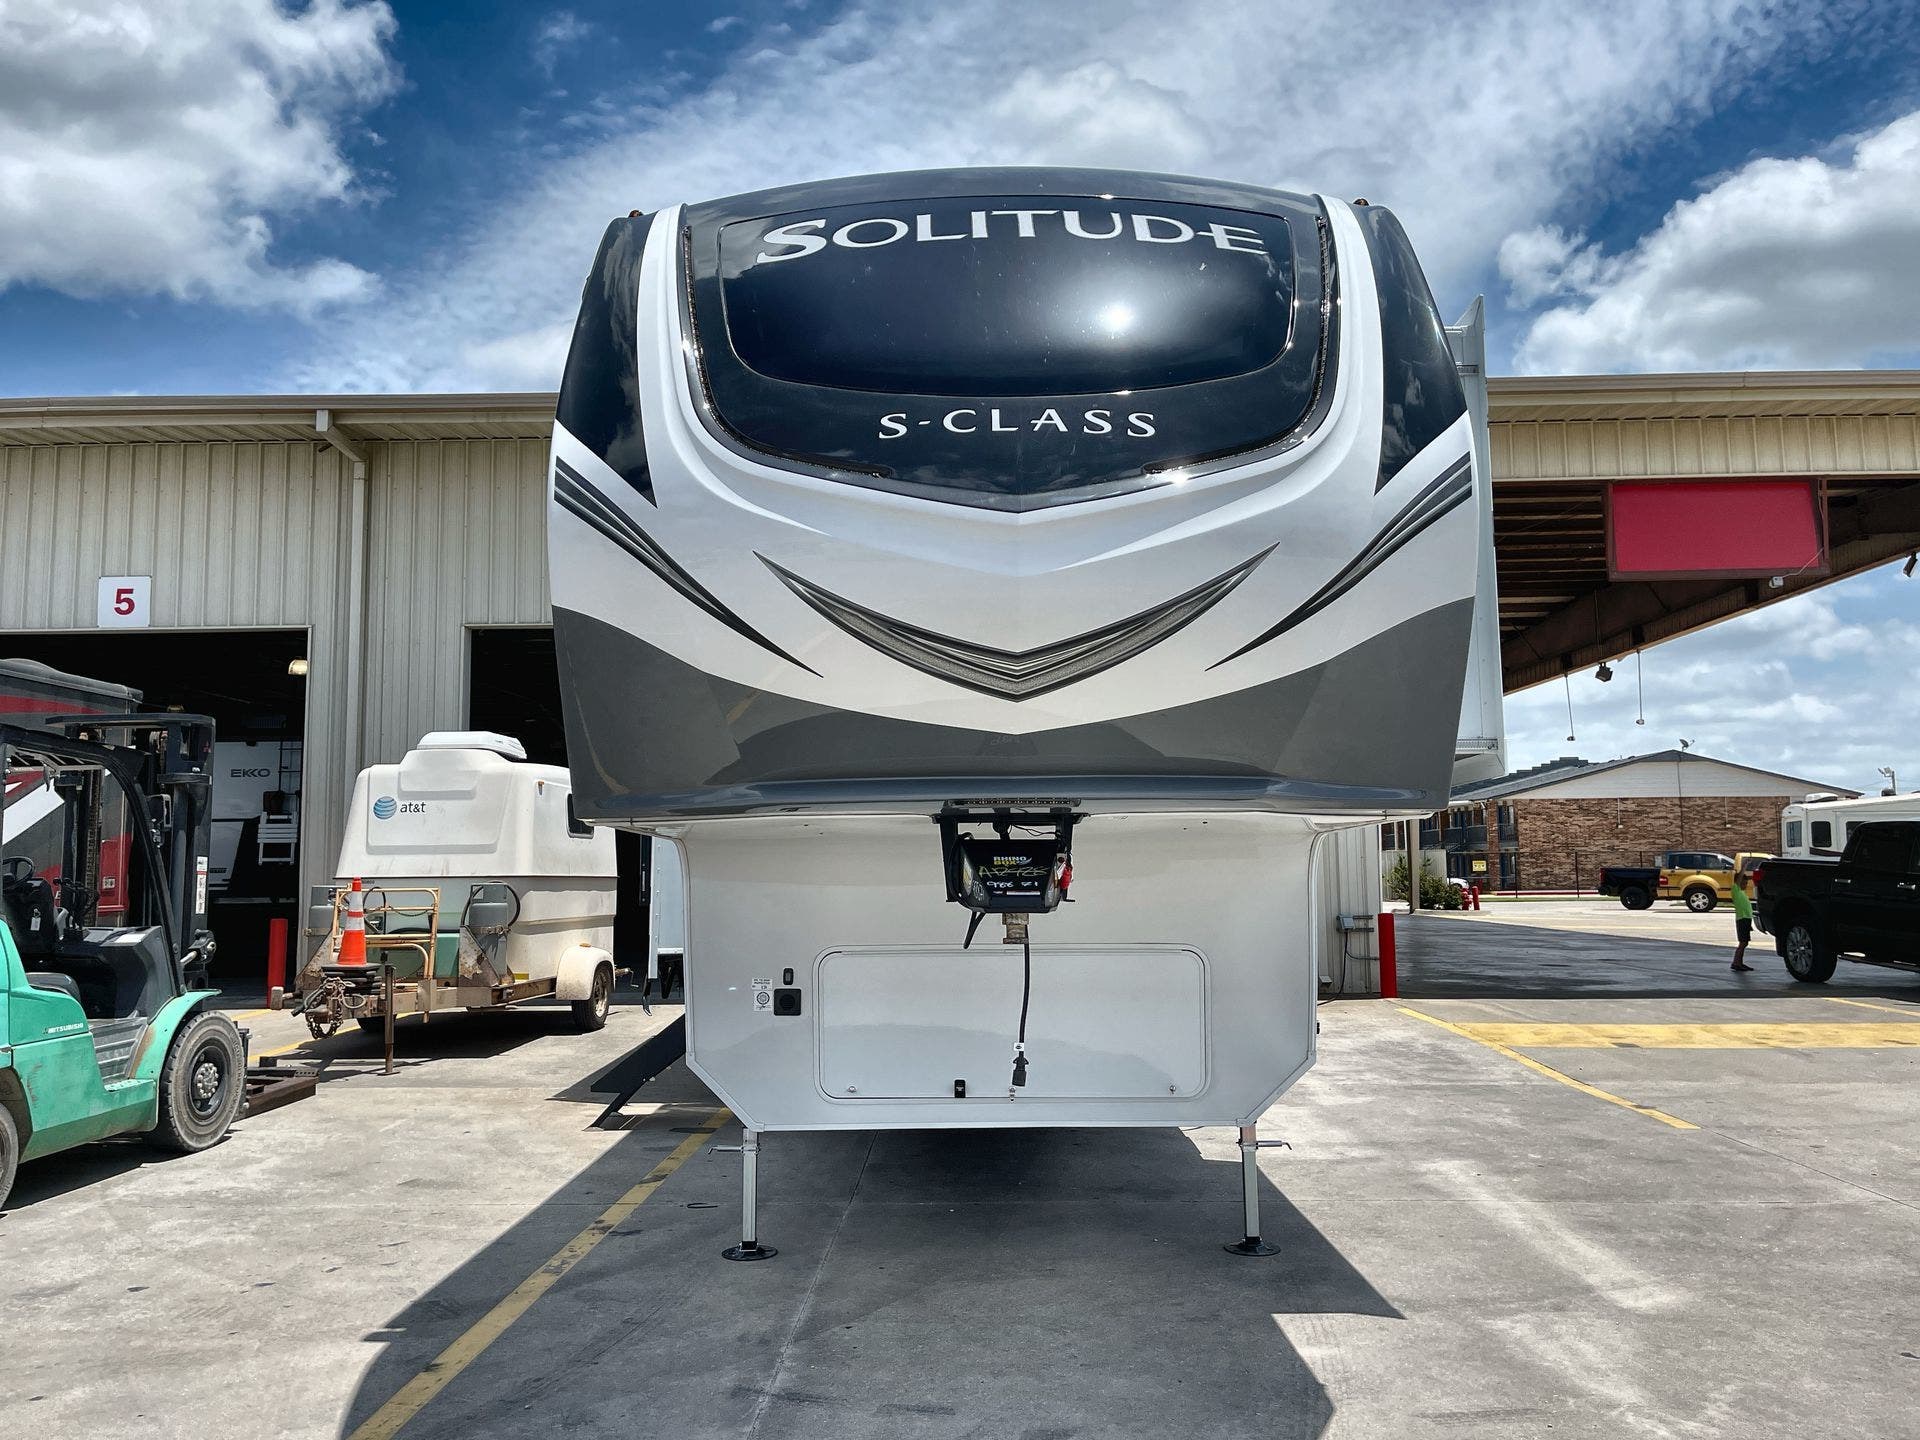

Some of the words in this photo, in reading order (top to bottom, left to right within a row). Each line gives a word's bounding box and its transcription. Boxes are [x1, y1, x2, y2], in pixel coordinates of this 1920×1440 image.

[756, 209, 1268, 264] SOLITUDE
[878, 408, 1156, 440] S-CLASS
[113, 588, 135, 616] 5
[230, 768, 271, 778] EKKO
[400, 801, 427, 813] at&t
[48, 1023, 84, 1034] MITSUBISHI
